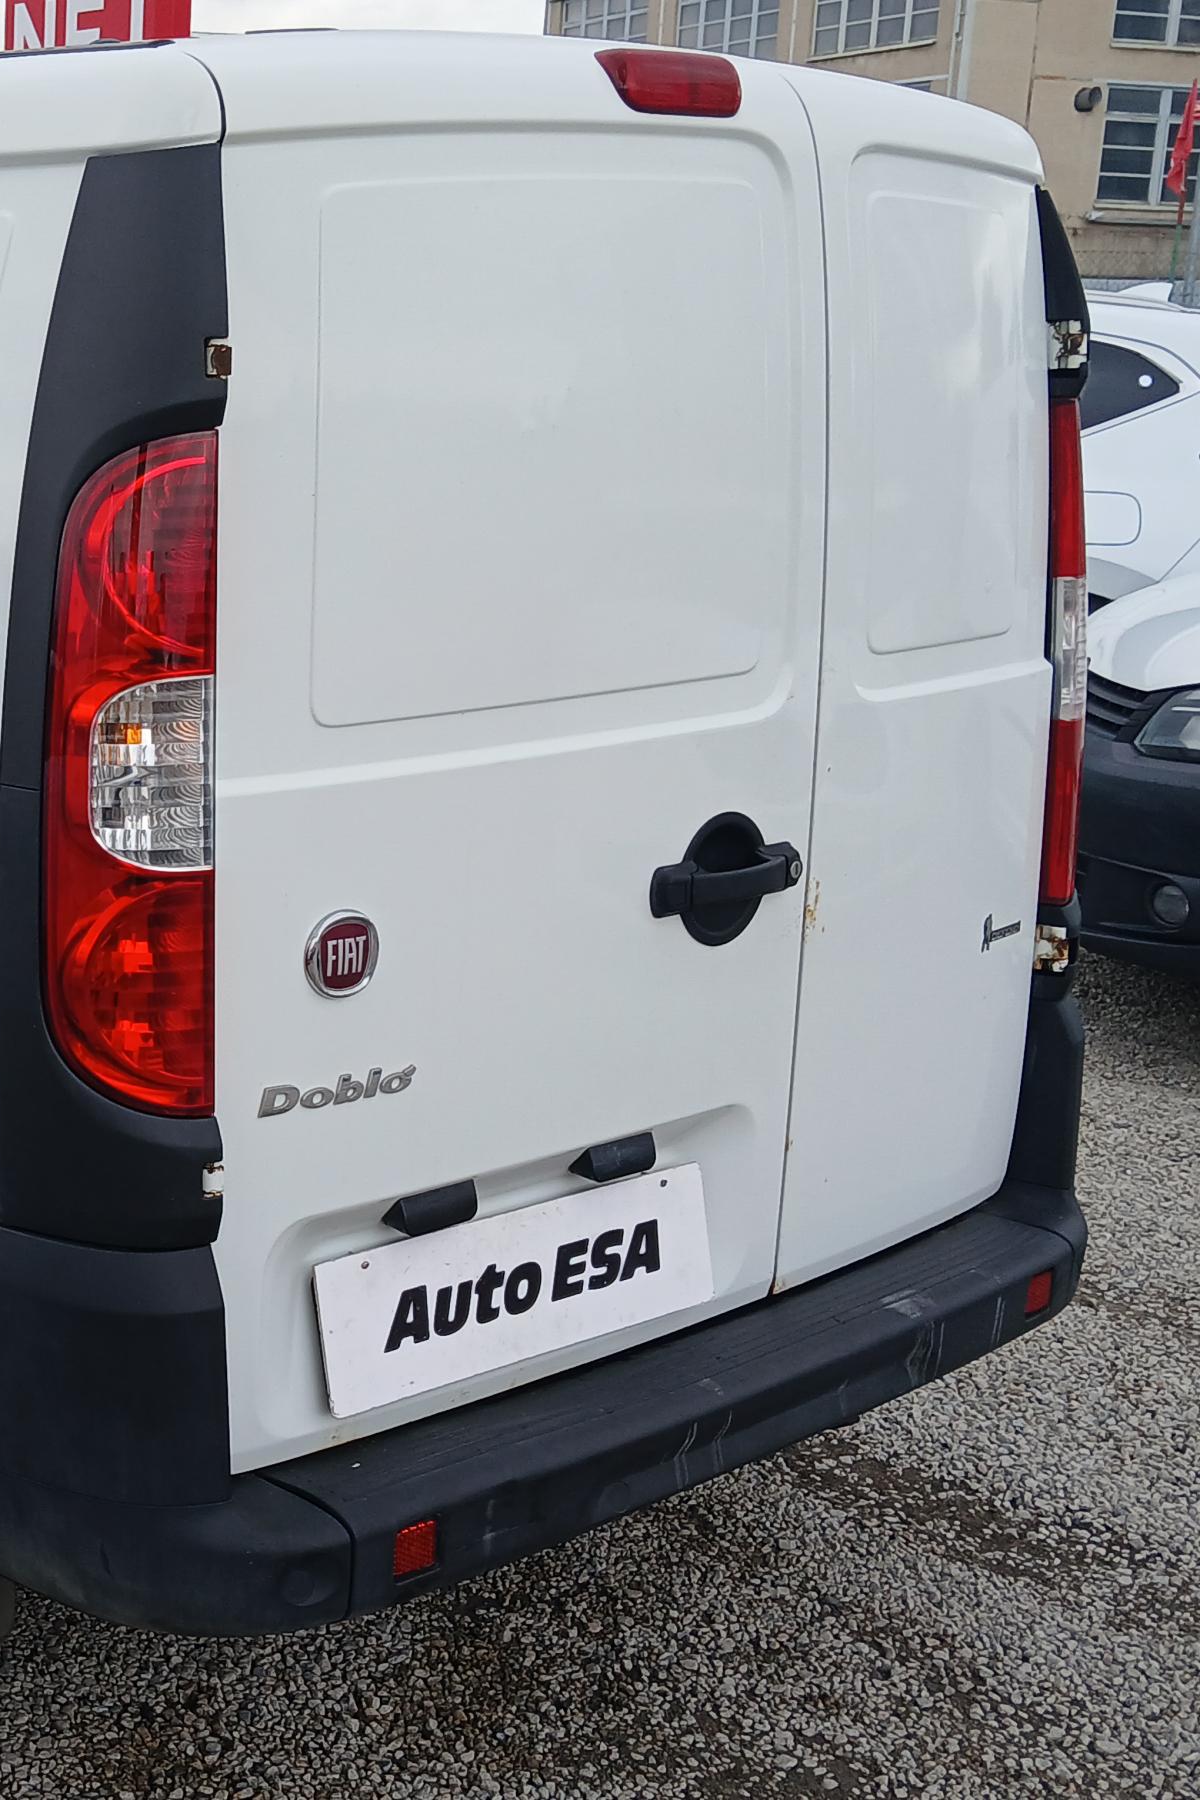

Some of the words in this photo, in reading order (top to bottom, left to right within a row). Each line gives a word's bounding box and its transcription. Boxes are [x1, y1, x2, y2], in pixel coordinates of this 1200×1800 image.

[326, 935, 367, 977] FIAT
[383, 1261, 542, 1353] Auto
[551, 1218, 661, 1302] ESA
